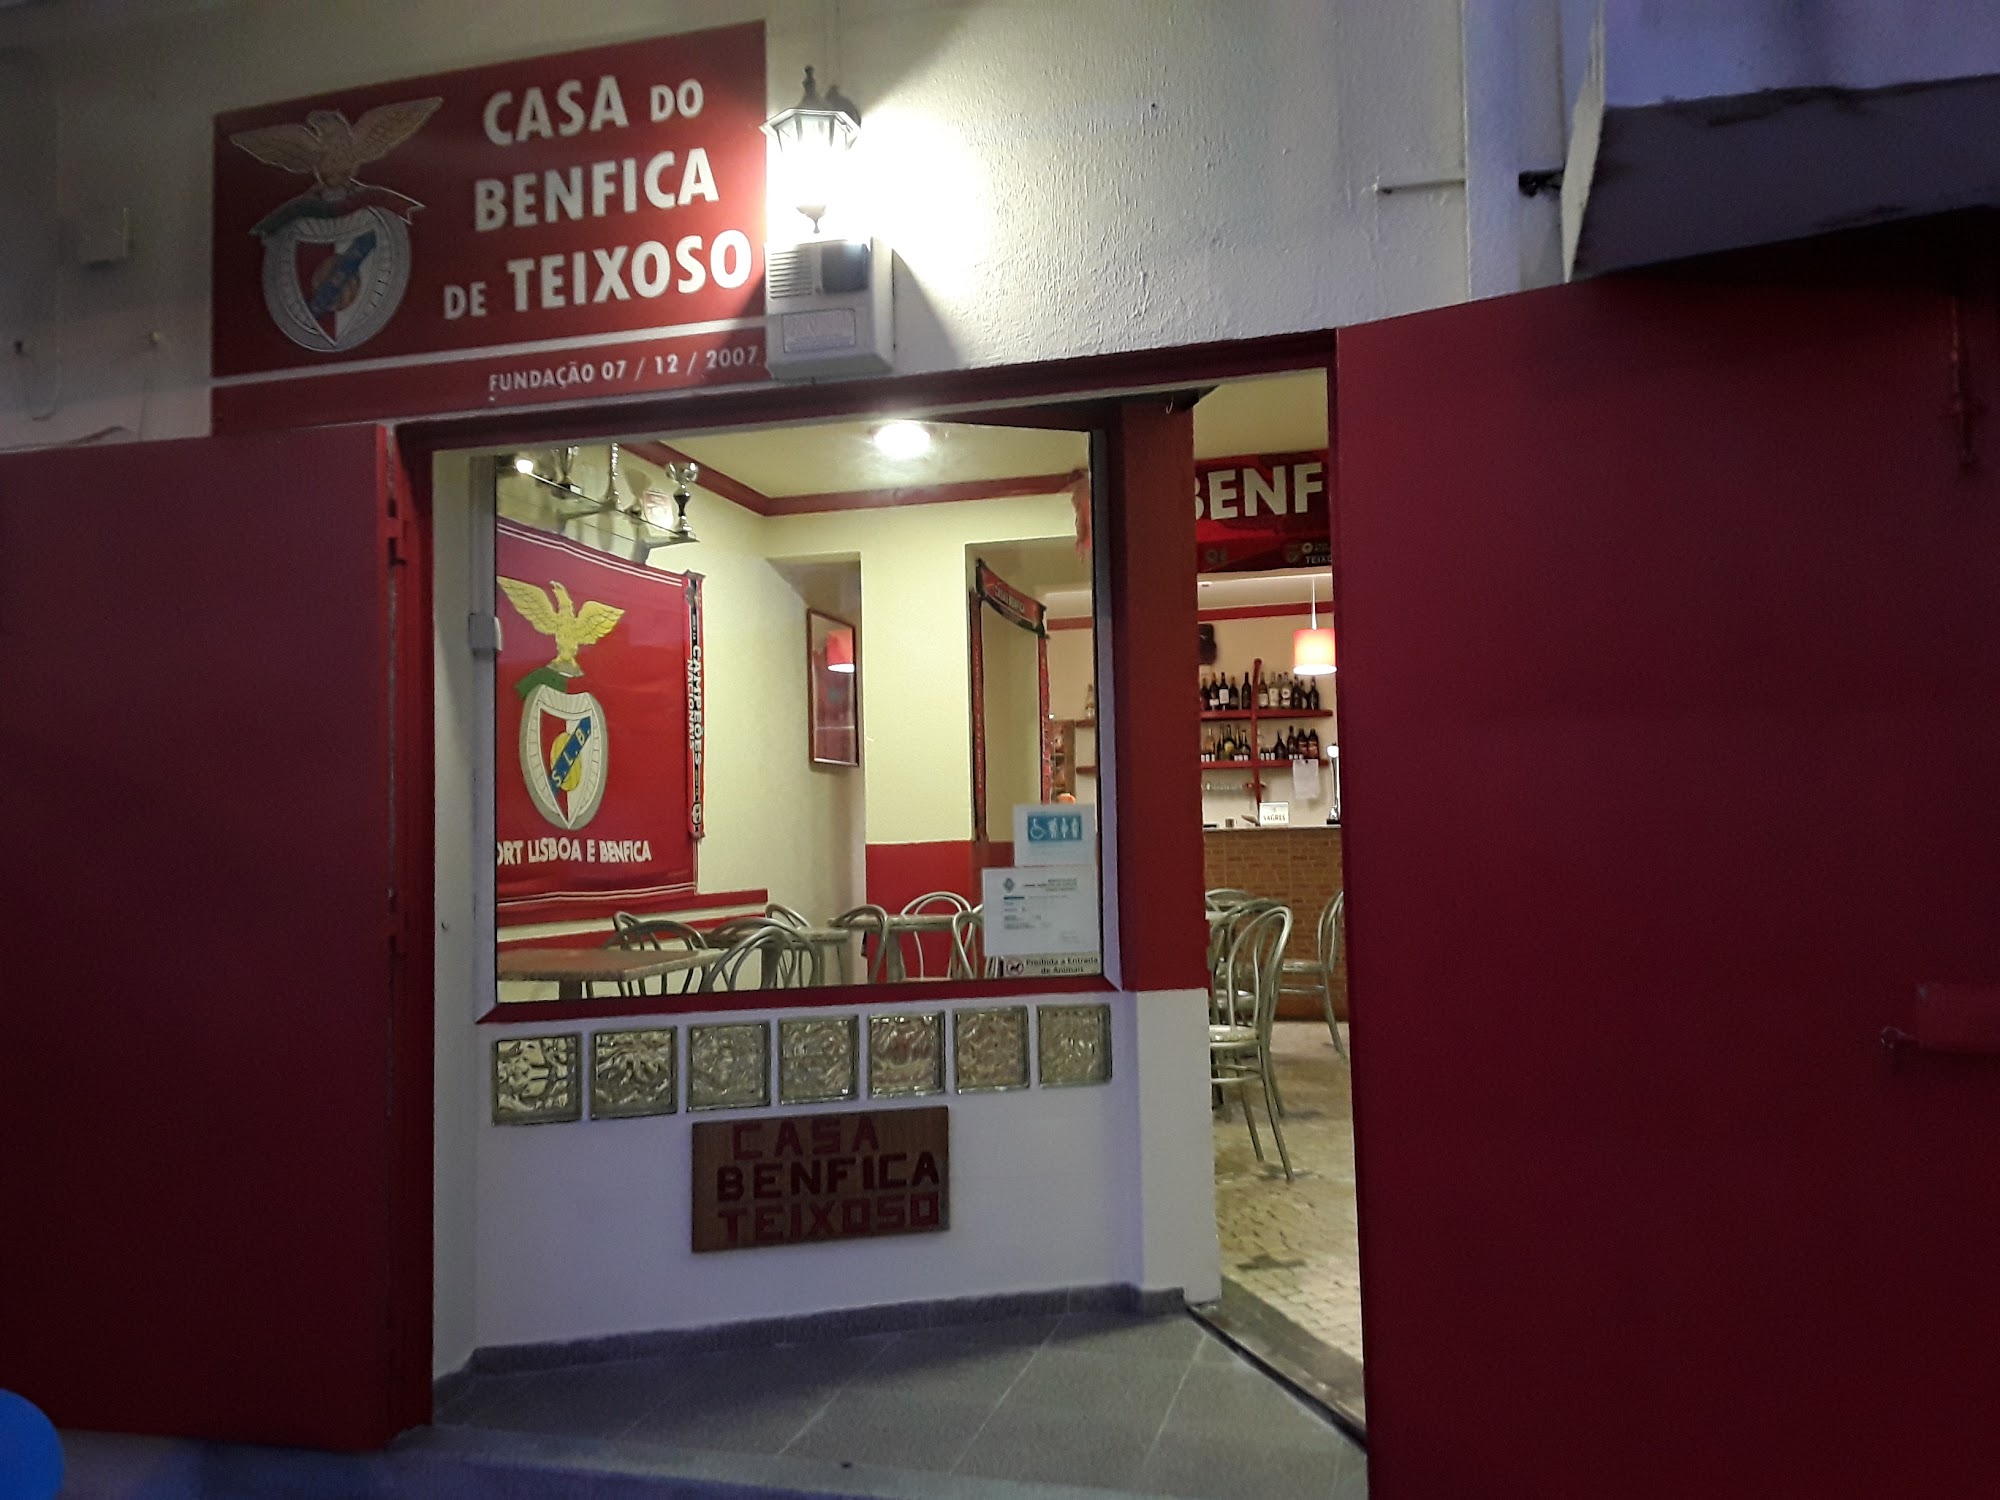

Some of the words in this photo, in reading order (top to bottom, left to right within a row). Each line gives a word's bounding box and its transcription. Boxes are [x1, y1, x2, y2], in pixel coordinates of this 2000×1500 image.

[483, 74, 629, 146] CASA
[649, 79, 703, 122] DO
[474, 147, 719, 233] BENFICA
[444, 282, 487, 320] DE
[507, 229, 753, 312] TEIXOSO
[488, 360, 594, 392] FUNDAÇÃO
[601, 360, 627, 381] 07
[655, 353, 679, 374] 12
[705, 346, 758, 369] 2007
[527, 837, 582, 863] LISBOA
[587, 839, 596, 863] E
[599, 840, 652, 863] BENFICA
[733, 1113, 880, 1160] CASA
[717, 1151, 940, 1202] BENFICA
[717, 1191, 939, 1244] TEIXOSO
